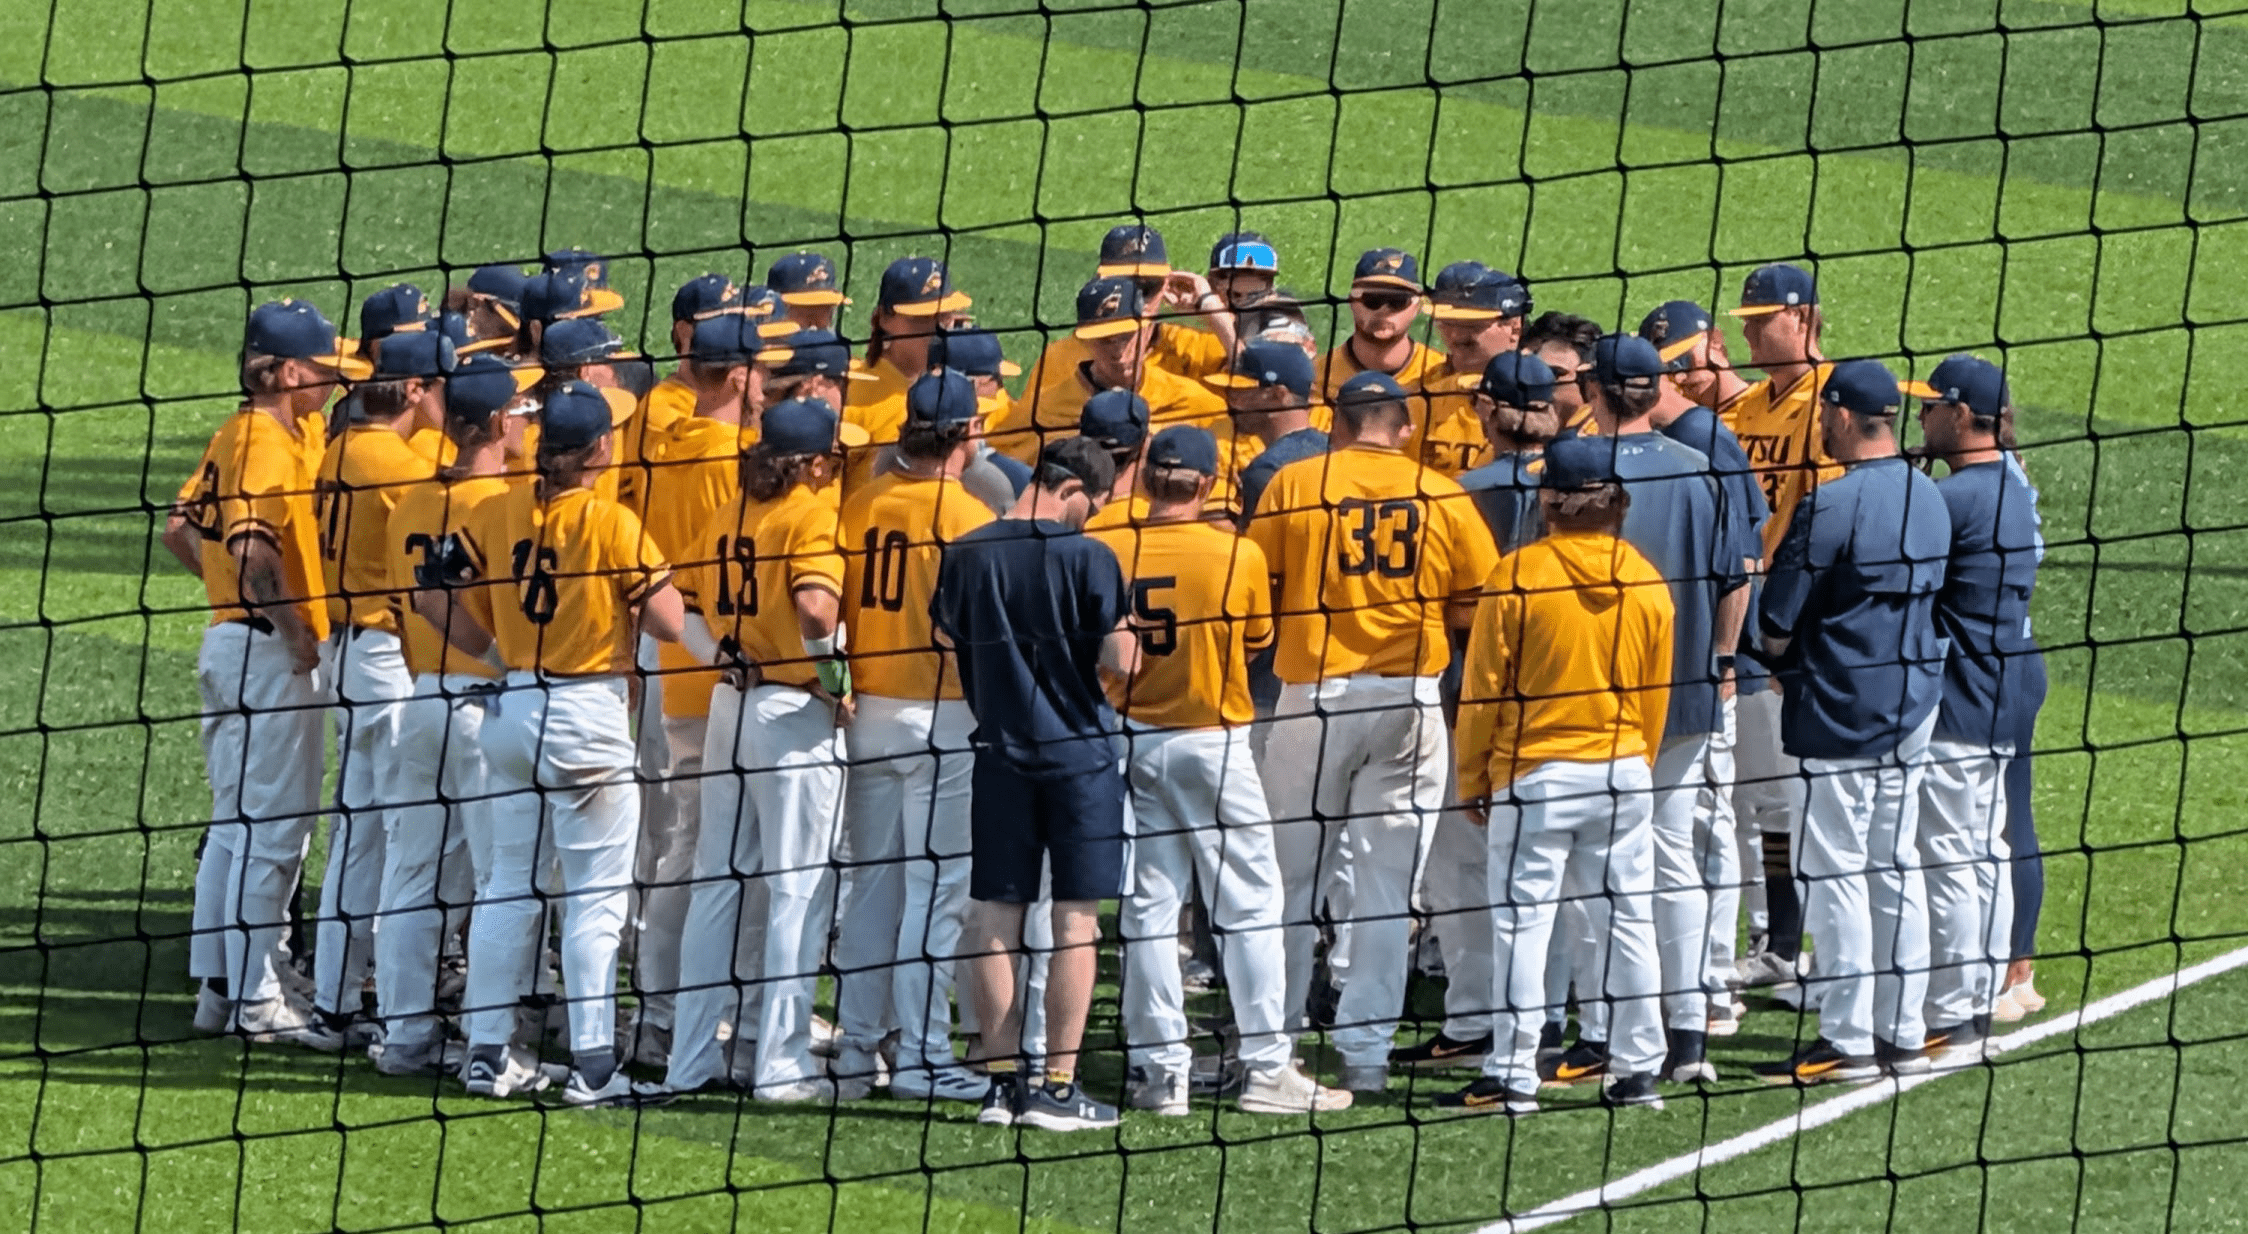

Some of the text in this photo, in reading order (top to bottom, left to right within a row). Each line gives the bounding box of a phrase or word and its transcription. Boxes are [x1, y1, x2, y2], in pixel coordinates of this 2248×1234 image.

[1737, 433, 1791, 464] TSU
[861, 527, 907, 612] 10
[1339, 498, 1419, 577] 33
[1133, 576, 1176, 656] 5
